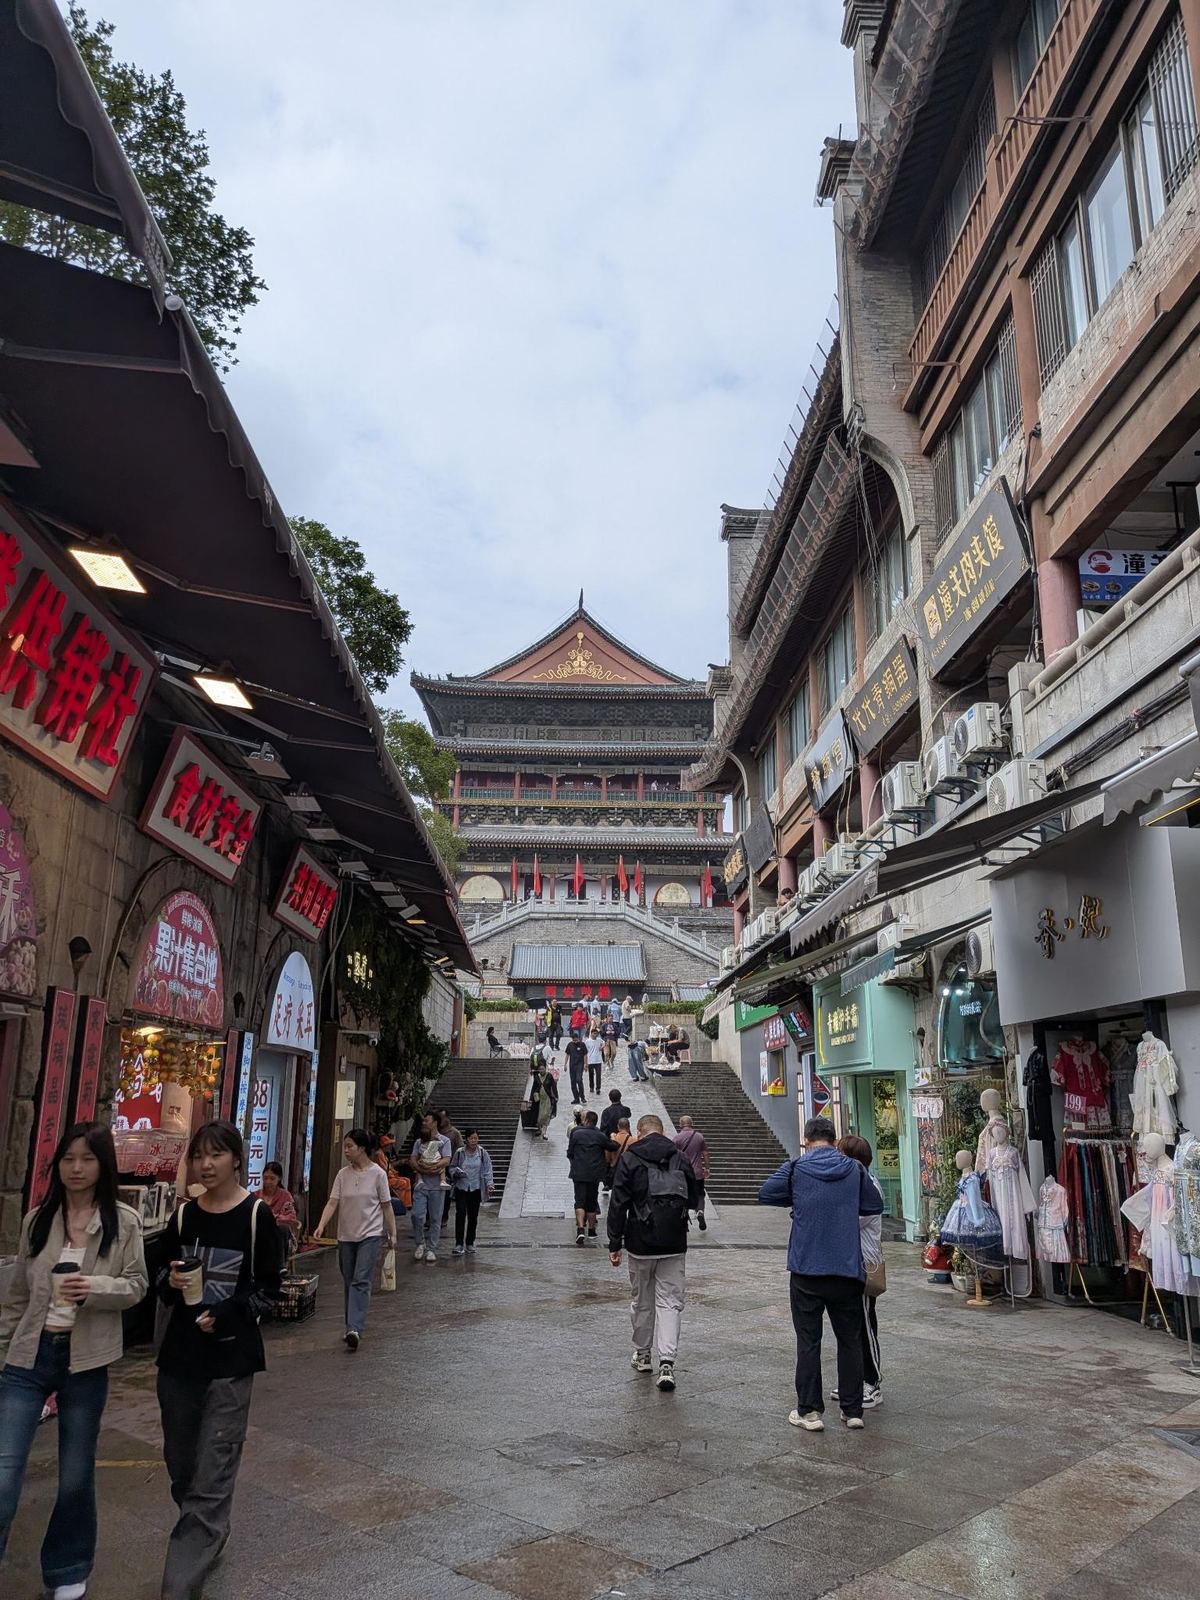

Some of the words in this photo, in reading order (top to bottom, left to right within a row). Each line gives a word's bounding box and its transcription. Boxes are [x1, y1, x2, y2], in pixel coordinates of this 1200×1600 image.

[153, 920, 219, 991] 果汁集合地
